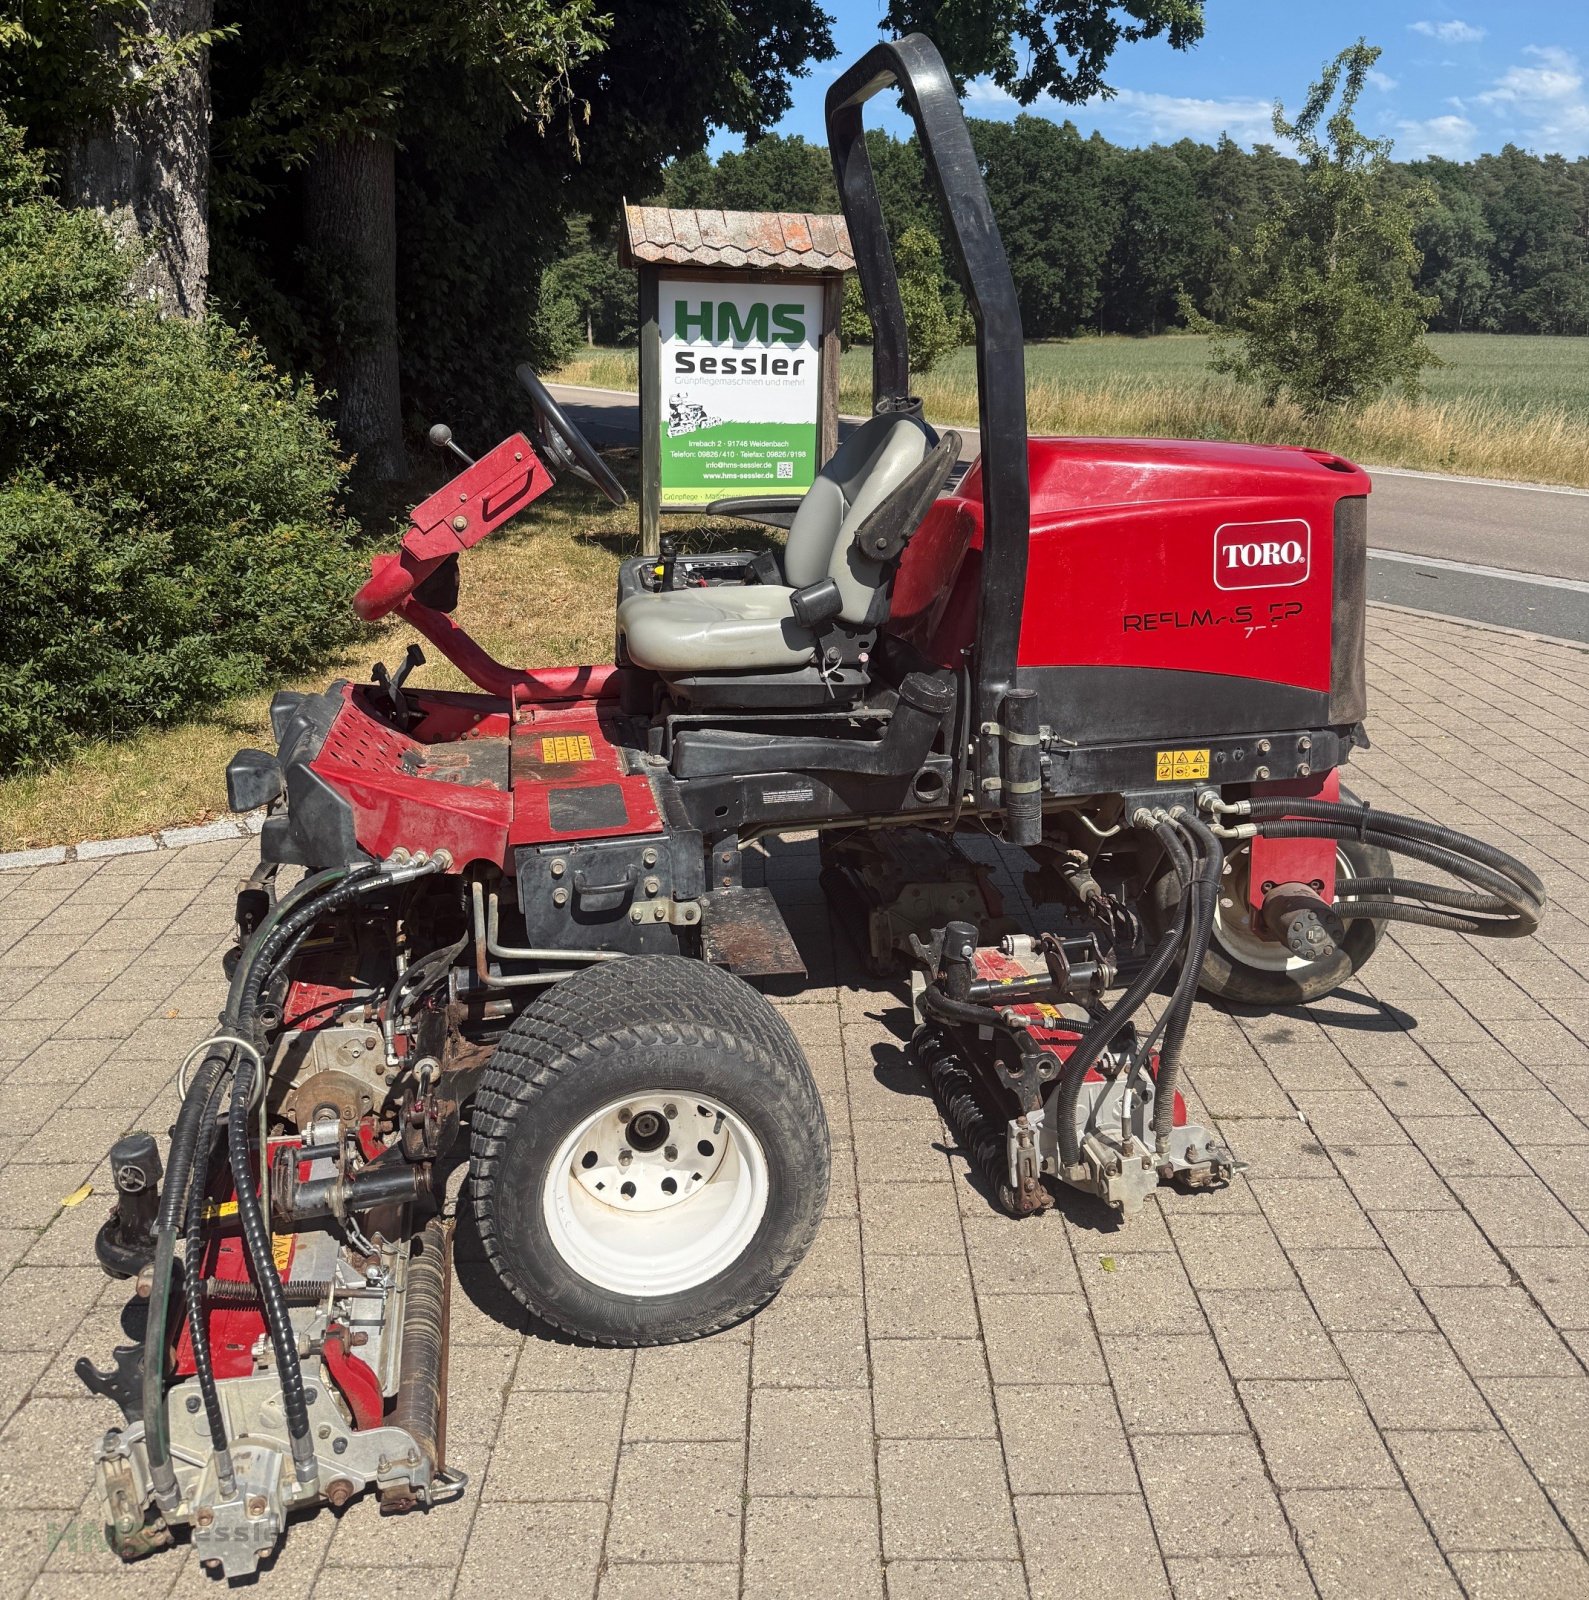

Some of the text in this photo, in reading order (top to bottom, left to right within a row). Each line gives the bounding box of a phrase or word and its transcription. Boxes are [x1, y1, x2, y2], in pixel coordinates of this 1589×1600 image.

[674, 300, 806, 344] HMS
[674, 351, 805, 376] Sessler
[674, 376, 764, 386] Grünpflegemaschinen
[765, 378, 781, 386] und
[705, 461, 772, 469] info@hms-sessler.de
